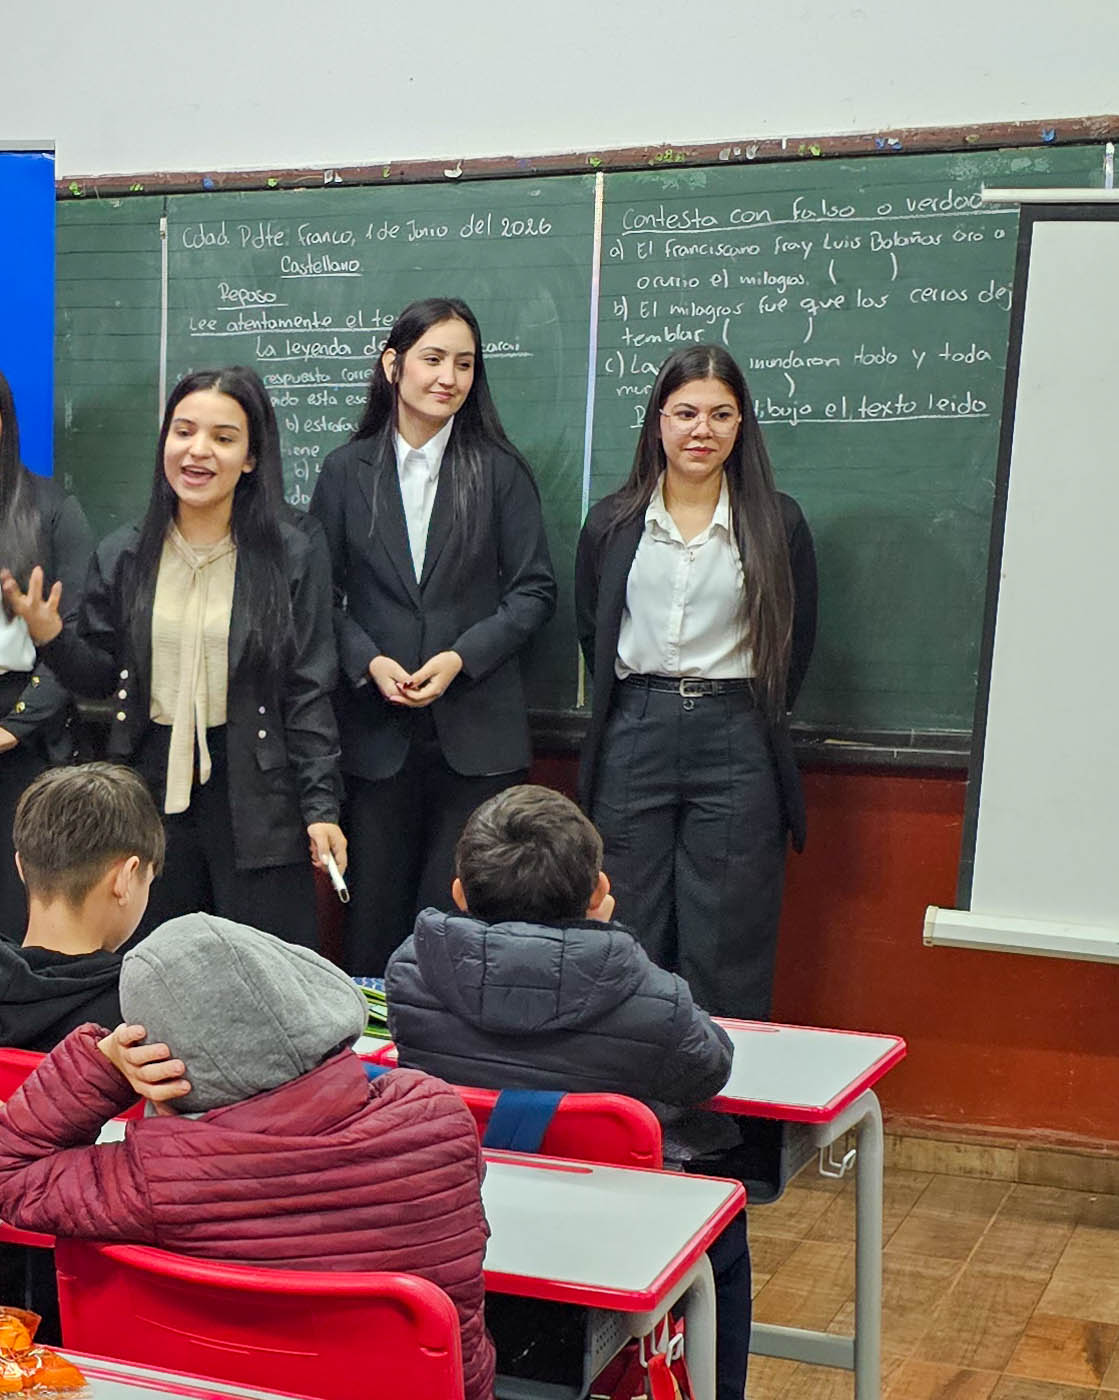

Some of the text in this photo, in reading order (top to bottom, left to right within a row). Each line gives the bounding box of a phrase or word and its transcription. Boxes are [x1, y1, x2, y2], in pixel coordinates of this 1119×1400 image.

[377, 221, 400, 241] de
[460, 212, 492, 238] del
[501, 217, 552, 237] 2026
[623, 205, 718, 230] Contesta
[730, 208, 772, 223] con
[877, 204, 892, 216] o
[610, 239, 623, 260] a)
[637, 241, 653, 259] El
[824, 234, 861, 249] Luis
[280, 253, 360, 274] Castellano
[711, 269, 728, 288] el
[217, 282, 277, 305] Repaso
[614, 296, 628, 321] b)
[640, 301, 657, 318] El
[670, 302, 744, 324] milagros
[759, 295, 788, 314] fue
[800, 294, 845, 316] que
[857, 289, 889, 308] los
[910, 287, 968, 303] cerros
[189, 316, 217, 331] Lee
[226, 309, 332, 332] atentamente
[346, 309, 363, 327] el
[256, 335, 277, 358] La
[286, 337, 351, 362] leyenda
[605, 351, 624, 378] c)
[749, 350, 840, 369] inundaron
[854, 343, 898, 366] todo
[912, 348, 926, 370] y
[938, 342, 992, 364] toda
[307, 390, 337, 406] esta
[858, 393, 917, 418] texto
[285, 413, 299, 433] b)
